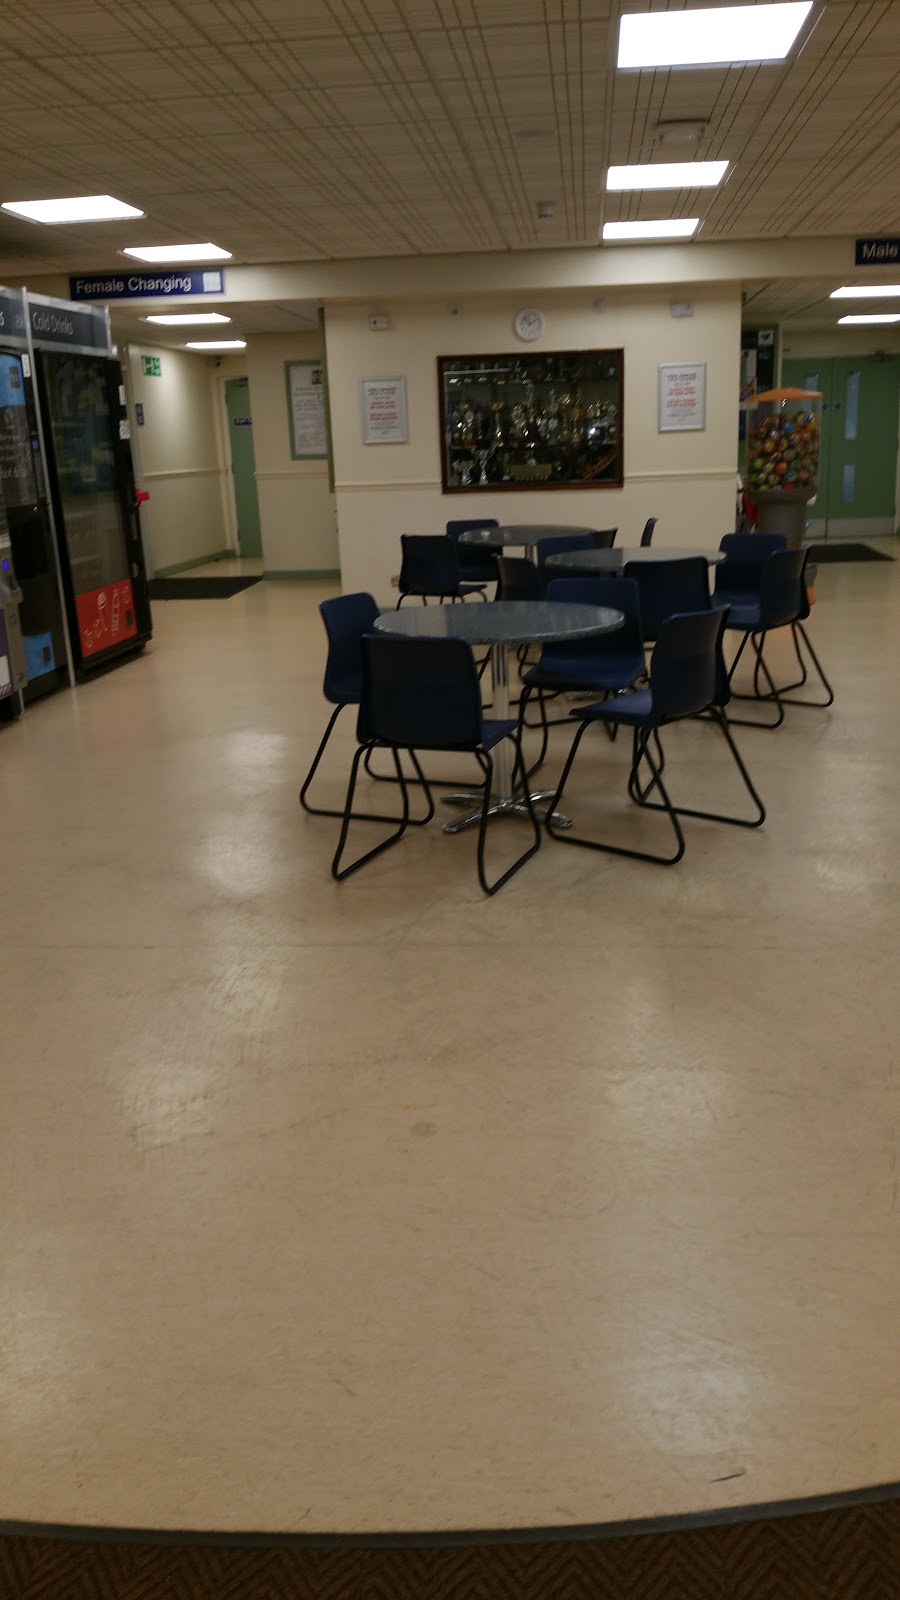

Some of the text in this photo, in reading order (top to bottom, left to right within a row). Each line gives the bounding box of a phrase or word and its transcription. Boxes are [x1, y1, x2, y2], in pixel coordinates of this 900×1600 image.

[863, 242, 898, 259] Male
[75, 275, 192, 294] Female Changing
[32, 312, 51, 332] Cold
[51, 314, 74, 336] Drinks
